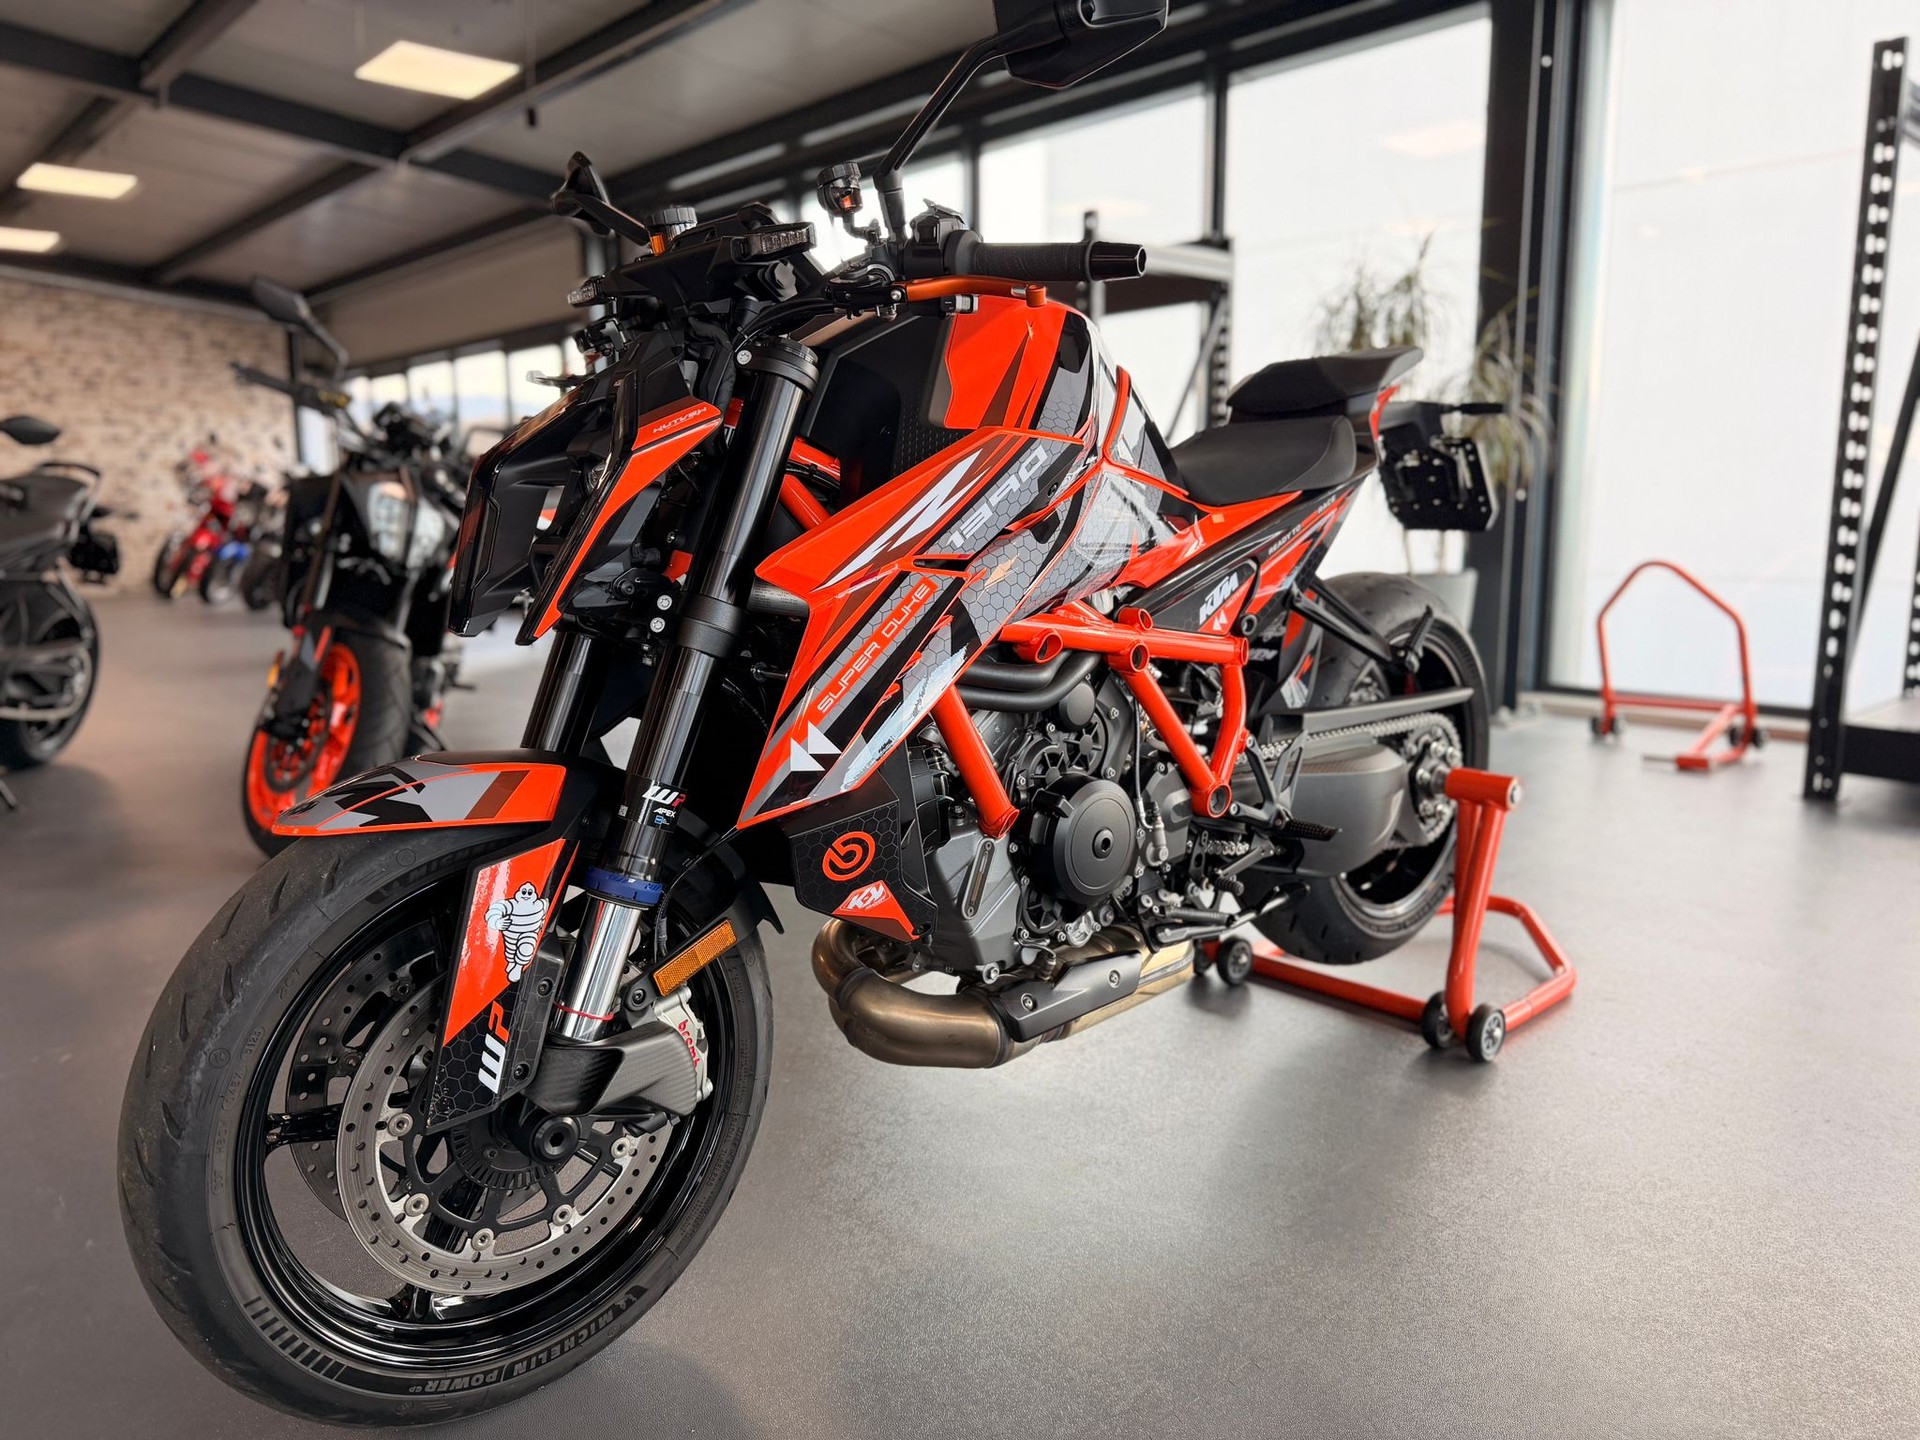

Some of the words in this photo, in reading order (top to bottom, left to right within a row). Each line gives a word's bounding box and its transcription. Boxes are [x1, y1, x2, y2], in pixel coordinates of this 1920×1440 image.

[945, 444, 1048, 548] 1390
[1268, 531, 1292, 556] READY
[1292, 523, 1301, 536] TO
[1318, 494, 1336, 514] RACE
[1199, 571, 1239, 626] KTM
[817, 641, 881, 714] SUPER
[881, 583, 931, 638] DUKE
[641, 785, 688, 808] WP
[653, 807, 677, 819] APEX
[477, 1000, 510, 1095] WP
[678, 1019, 701, 1069] bremb
[512, 1309, 614, 1377] MICHELIN
[424, 1369, 499, 1393] POWER
